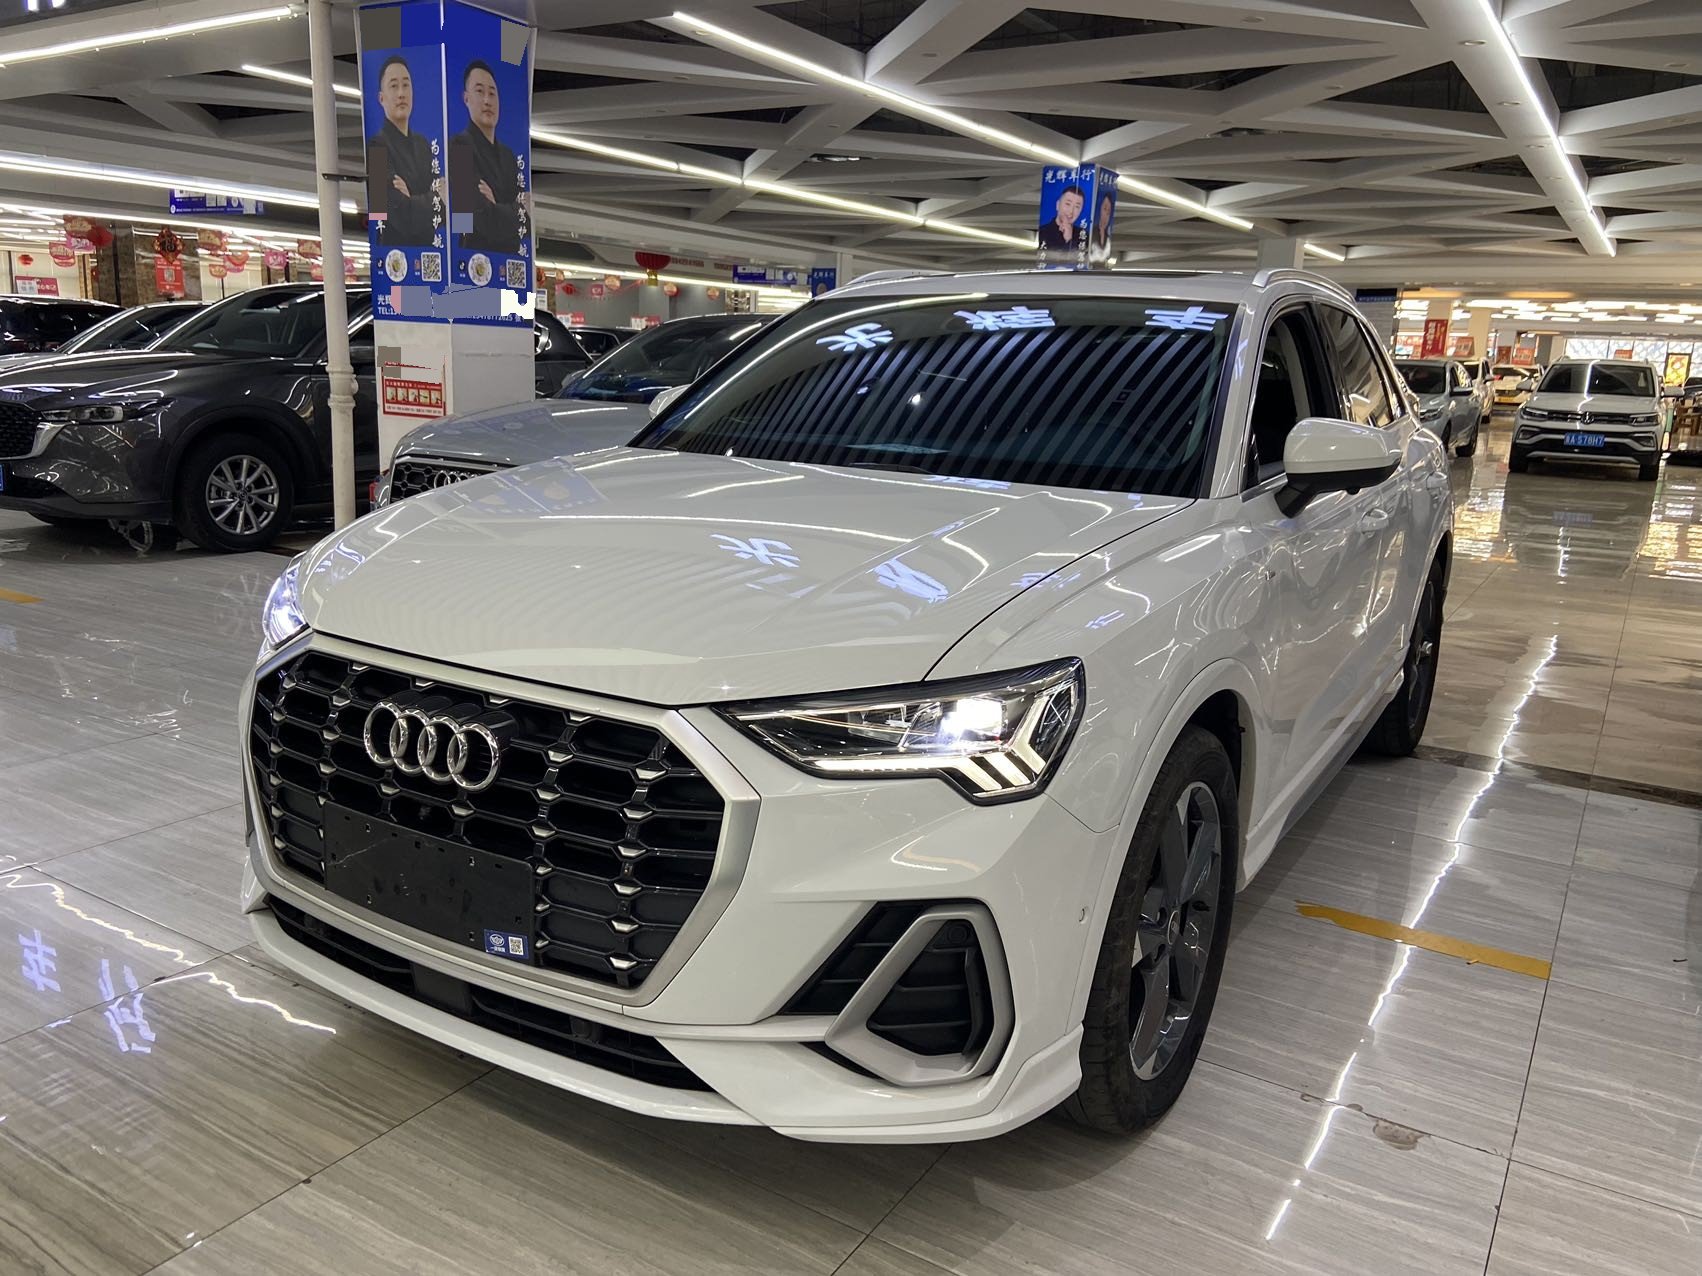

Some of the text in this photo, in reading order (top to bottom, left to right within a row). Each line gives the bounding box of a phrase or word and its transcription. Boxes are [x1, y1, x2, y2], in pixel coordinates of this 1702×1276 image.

[431, 138, 444, 249] 为您保驾护航
[516, 154, 529, 258] 为您保驾护航
[1045, 169, 1096, 183] 光辉车行
